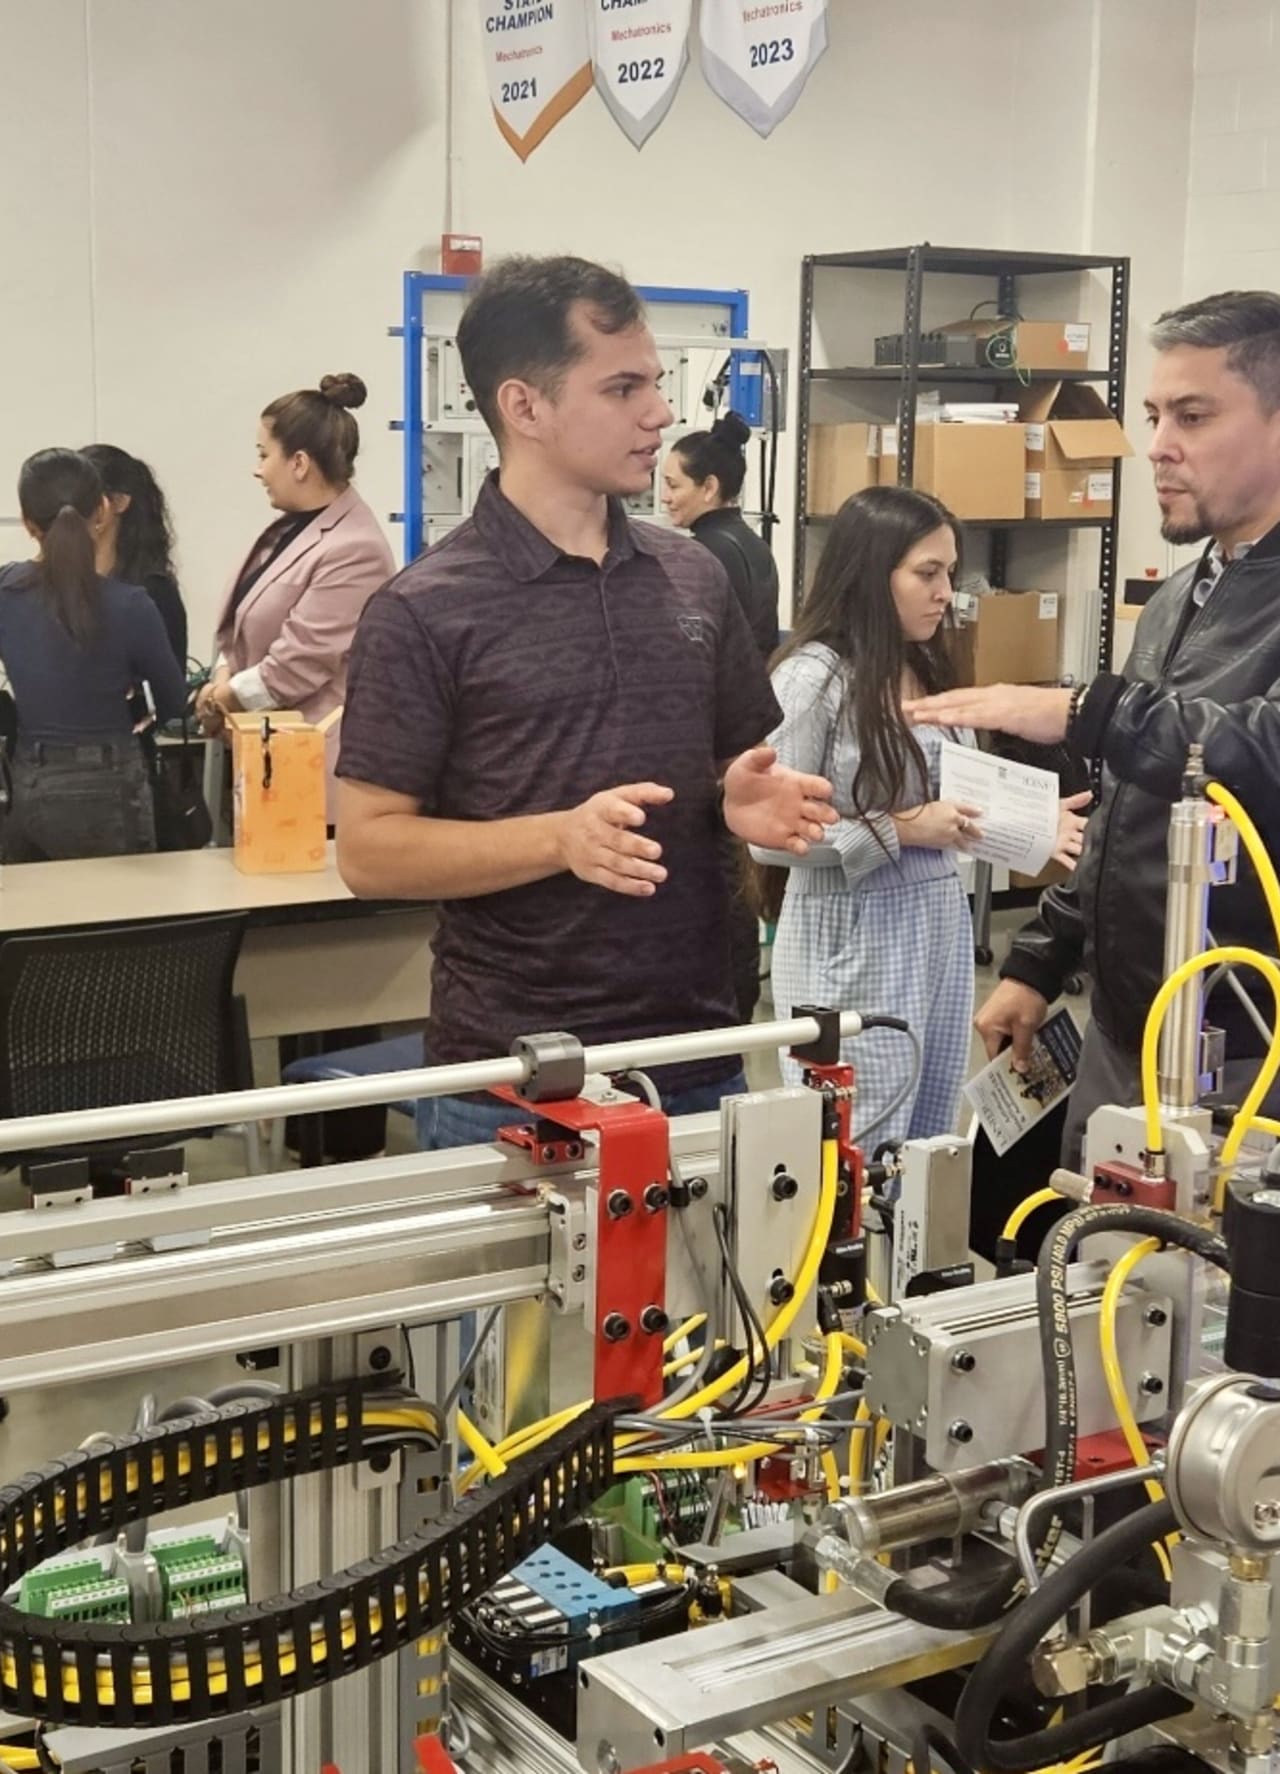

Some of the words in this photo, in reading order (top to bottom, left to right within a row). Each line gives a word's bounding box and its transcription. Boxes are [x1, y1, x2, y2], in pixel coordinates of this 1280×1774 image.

[486, 3, 553, 33] CHAMPION
[610, 22, 672, 41] Mechatronics
[495, 44, 544, 63] Mechatronics
[749, 38, 794, 68] 2023
[617, 57, 665, 84] 2022
[501, 77, 538, 103] 2021
[1052, 1294, 1069, 1334] 5800
